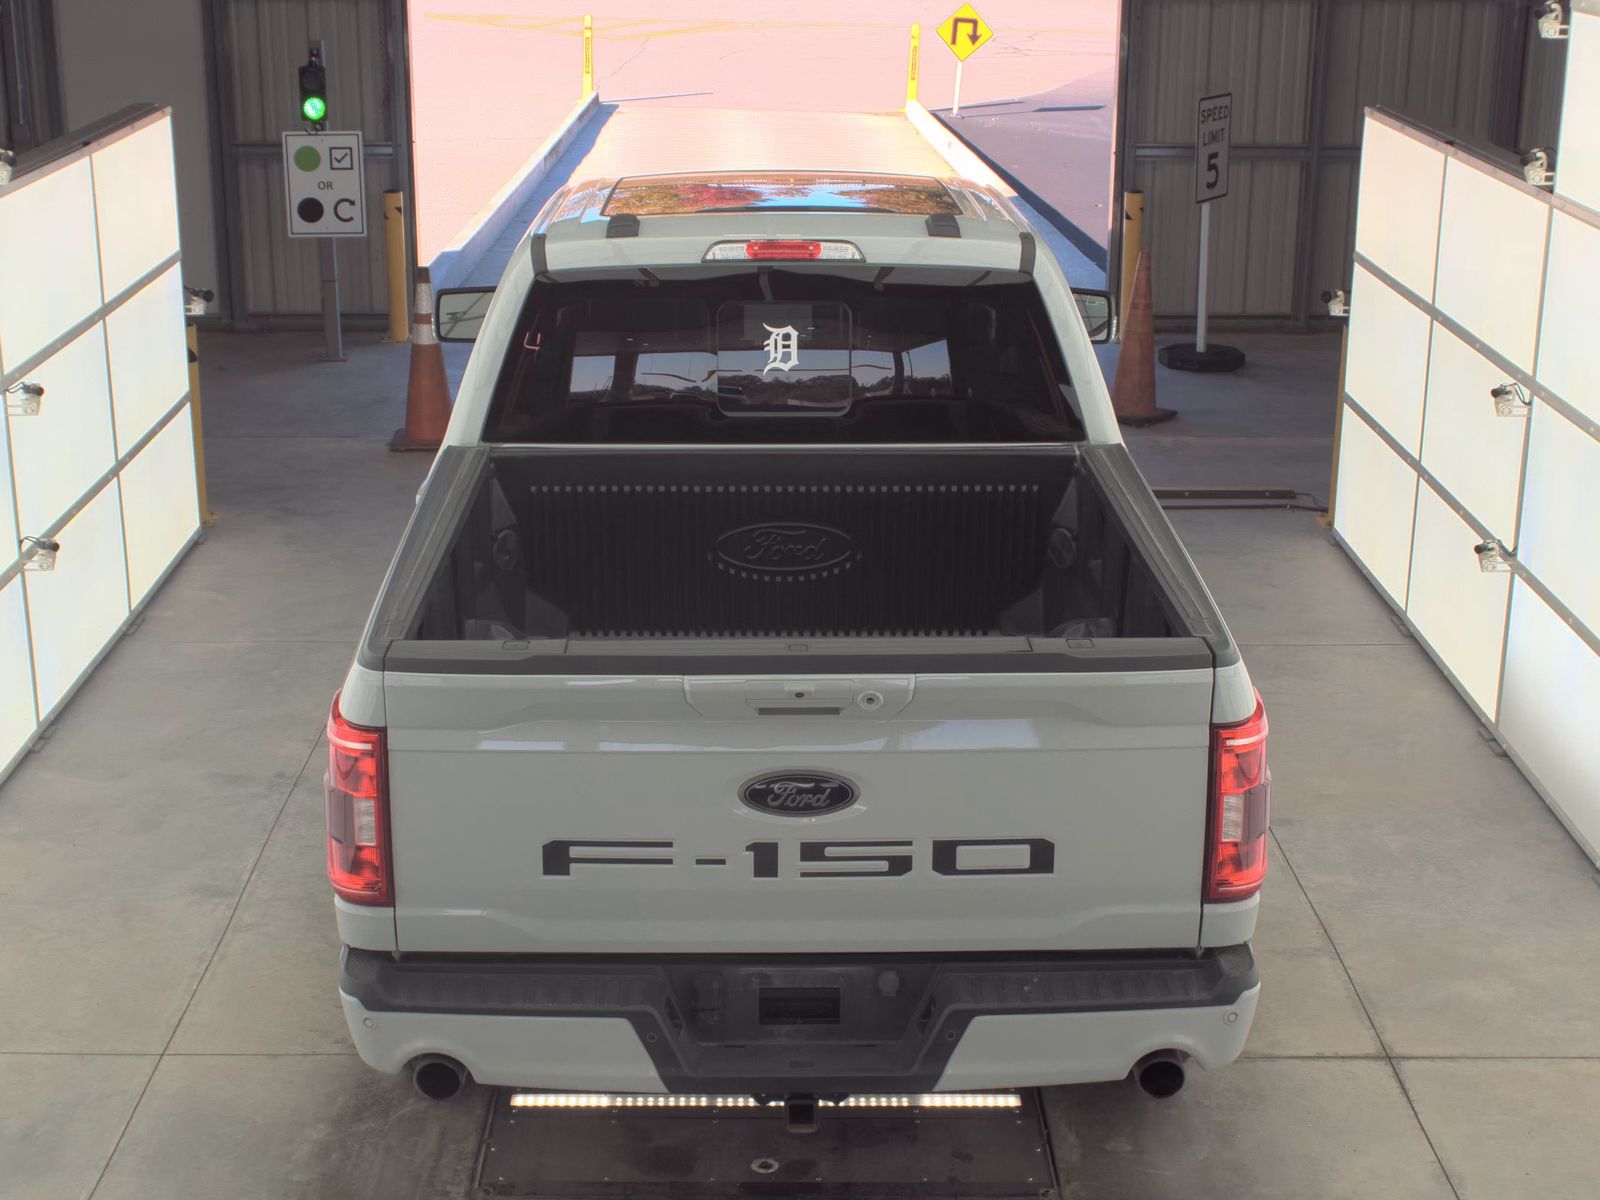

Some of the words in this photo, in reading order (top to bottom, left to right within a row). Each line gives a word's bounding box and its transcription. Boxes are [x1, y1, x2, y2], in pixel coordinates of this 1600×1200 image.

[1201, 105, 1229, 124] SPEED
[1203, 127, 1226, 146] LIMIT
[1206, 151, 1220, 190] 5
[318, 181, 333, 190] OR
[744, 529, 827, 561] Ford
[767, 781, 831, 807] Ford
[542, 838, 1055, 878] F-150
